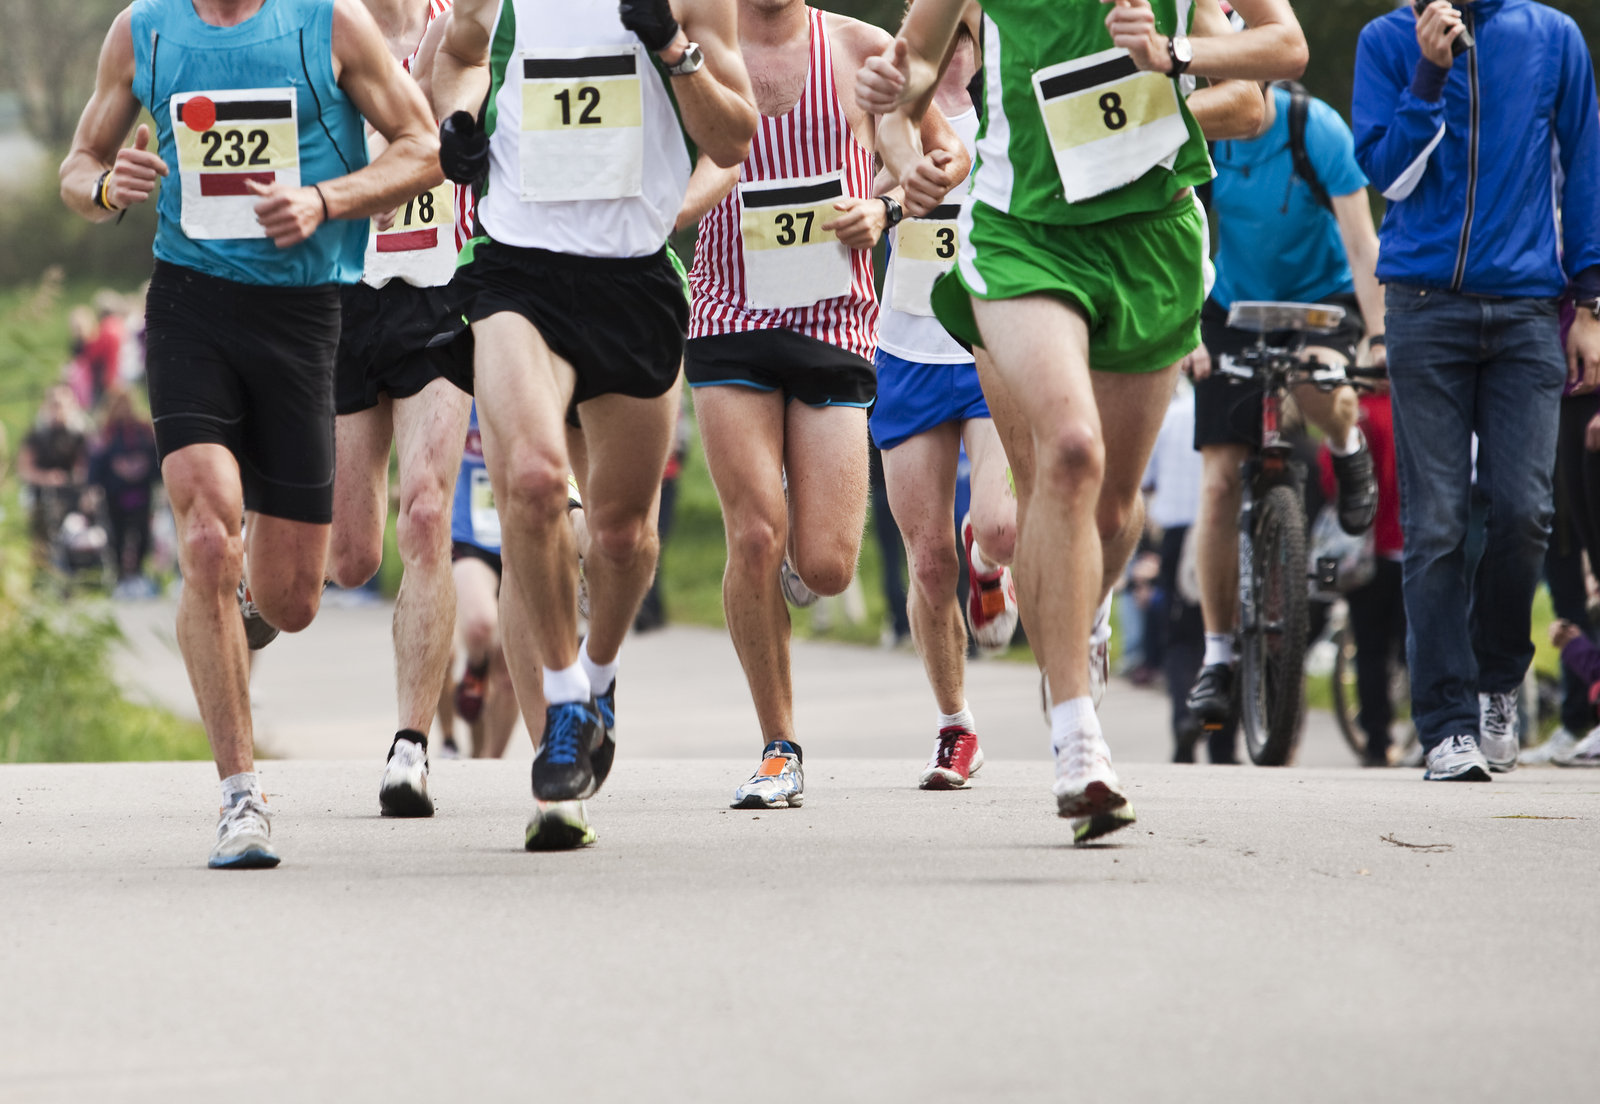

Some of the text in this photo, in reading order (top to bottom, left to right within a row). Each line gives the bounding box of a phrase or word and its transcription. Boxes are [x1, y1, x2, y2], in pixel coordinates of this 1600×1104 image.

[554, 87, 602, 125] 12
[1098, 92, 1128, 131] 8
[201, 130, 271, 167] 232
[774, 211, 815, 246] 37
[936, 227, 955, 259] 3
